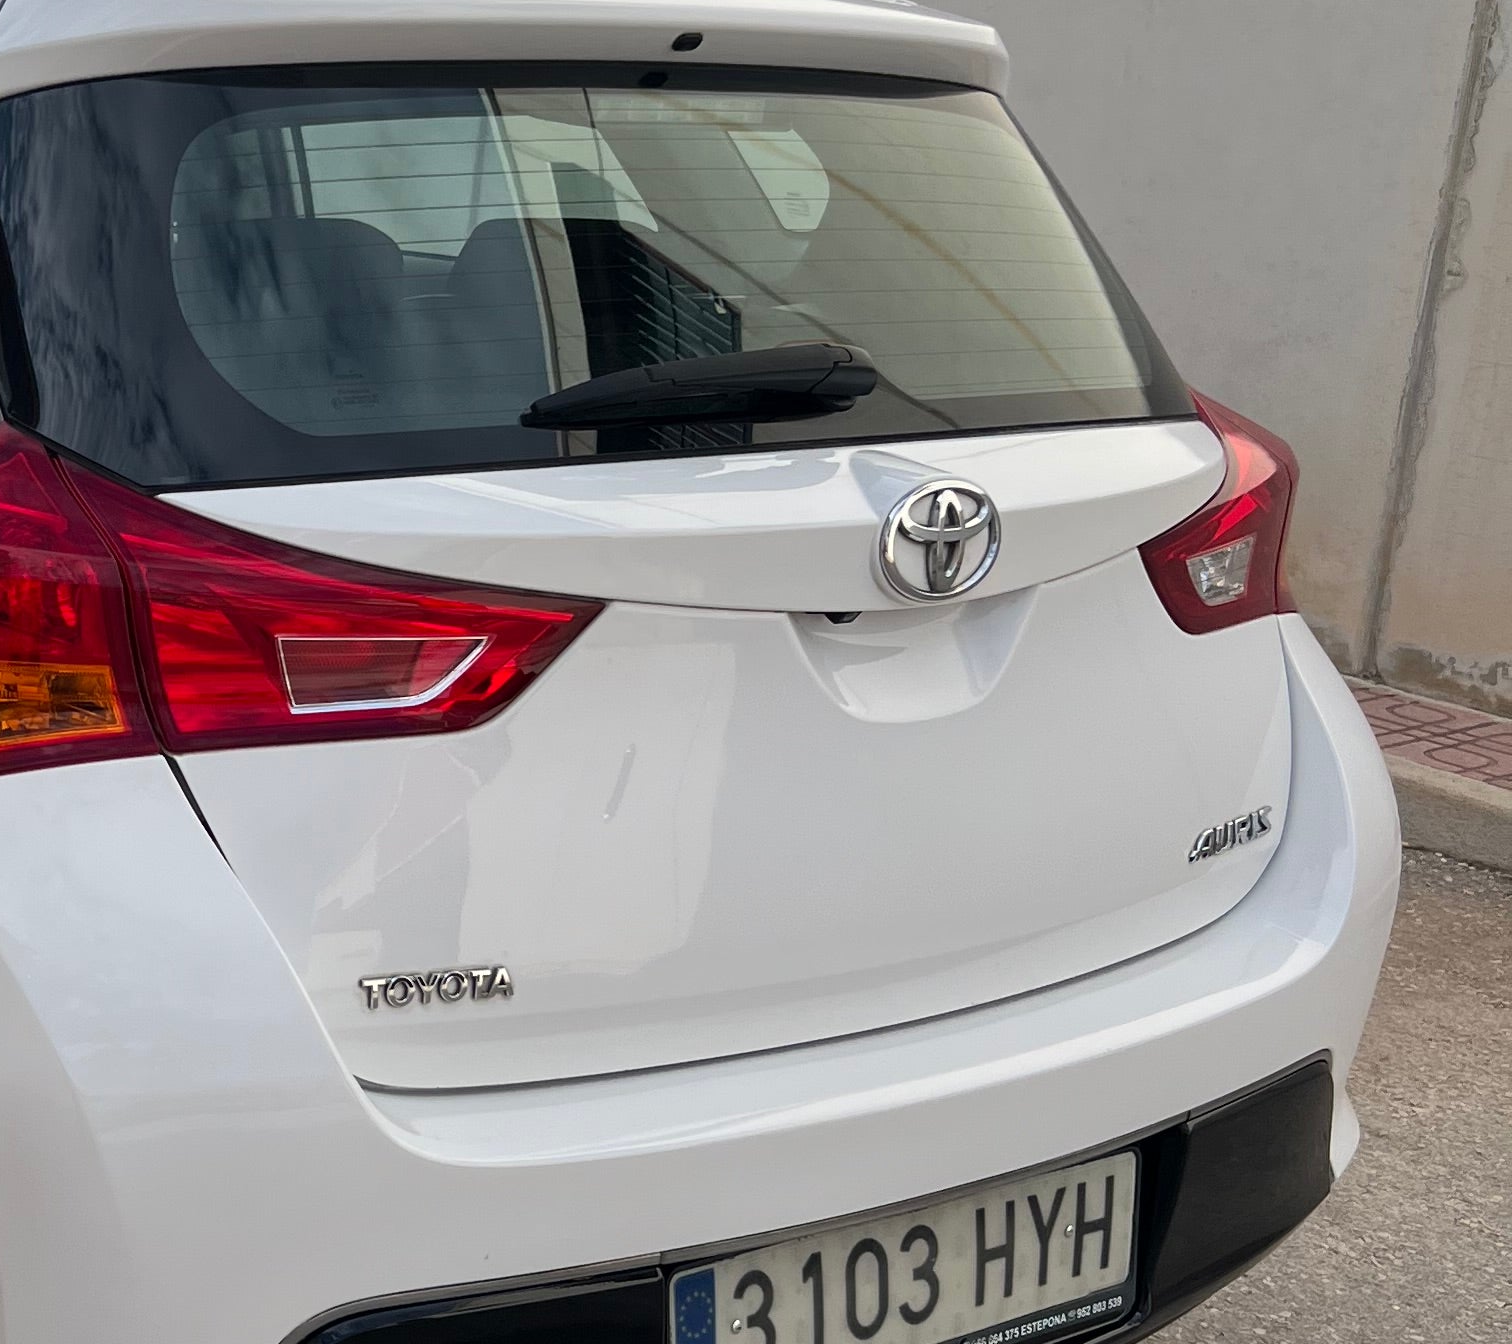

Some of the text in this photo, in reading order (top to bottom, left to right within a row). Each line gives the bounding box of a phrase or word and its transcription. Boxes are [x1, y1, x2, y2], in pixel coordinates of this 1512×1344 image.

[1188, 805, 1272, 864] AURIS
[359, 964, 514, 1010] TOYOTA
[975, 1175, 1115, 1307] HYH
[1004, 1326, 1020, 1341] 375
[1020, 1313, 1067, 1336] ESTEPONA
